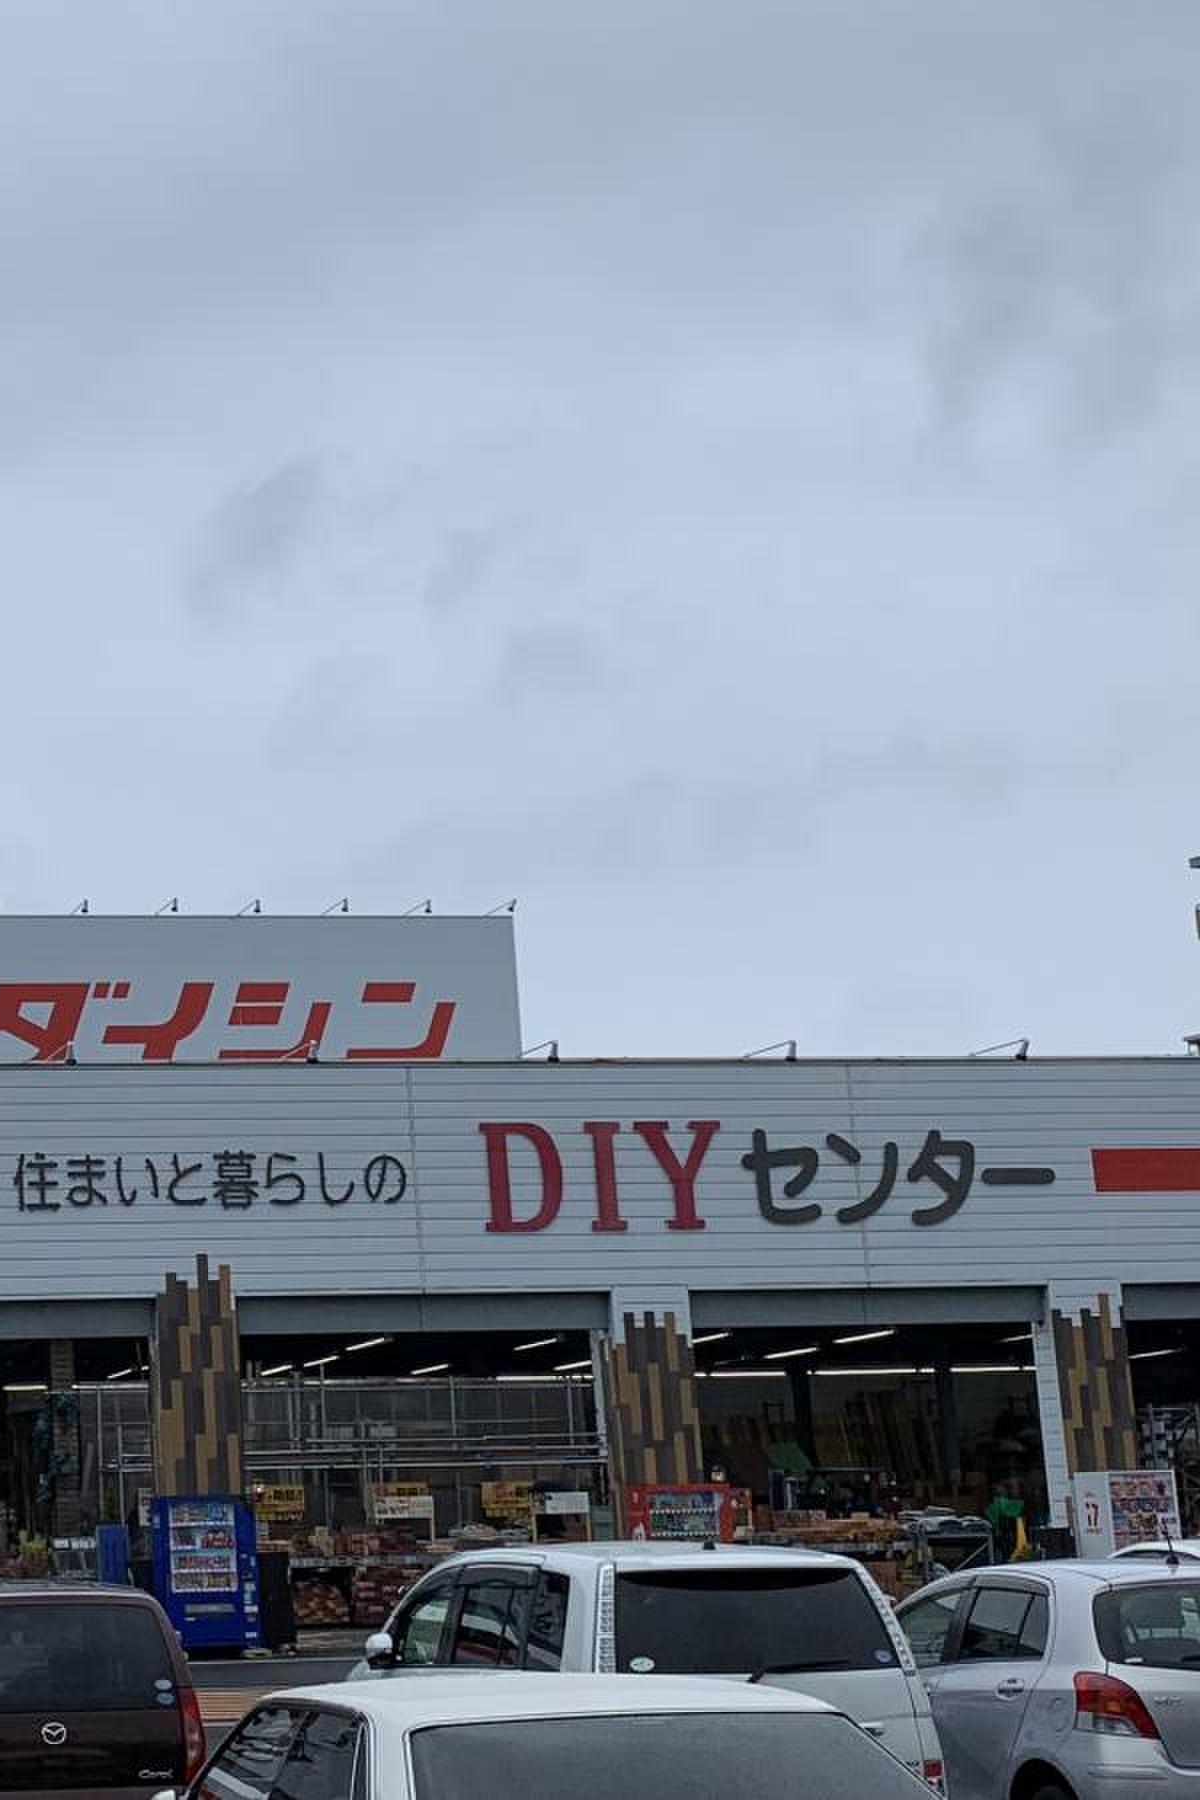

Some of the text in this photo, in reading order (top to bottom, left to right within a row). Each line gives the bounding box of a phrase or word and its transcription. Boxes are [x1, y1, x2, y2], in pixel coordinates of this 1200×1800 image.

[12, 1151, 408, 1213] 住まいと暮らしの
